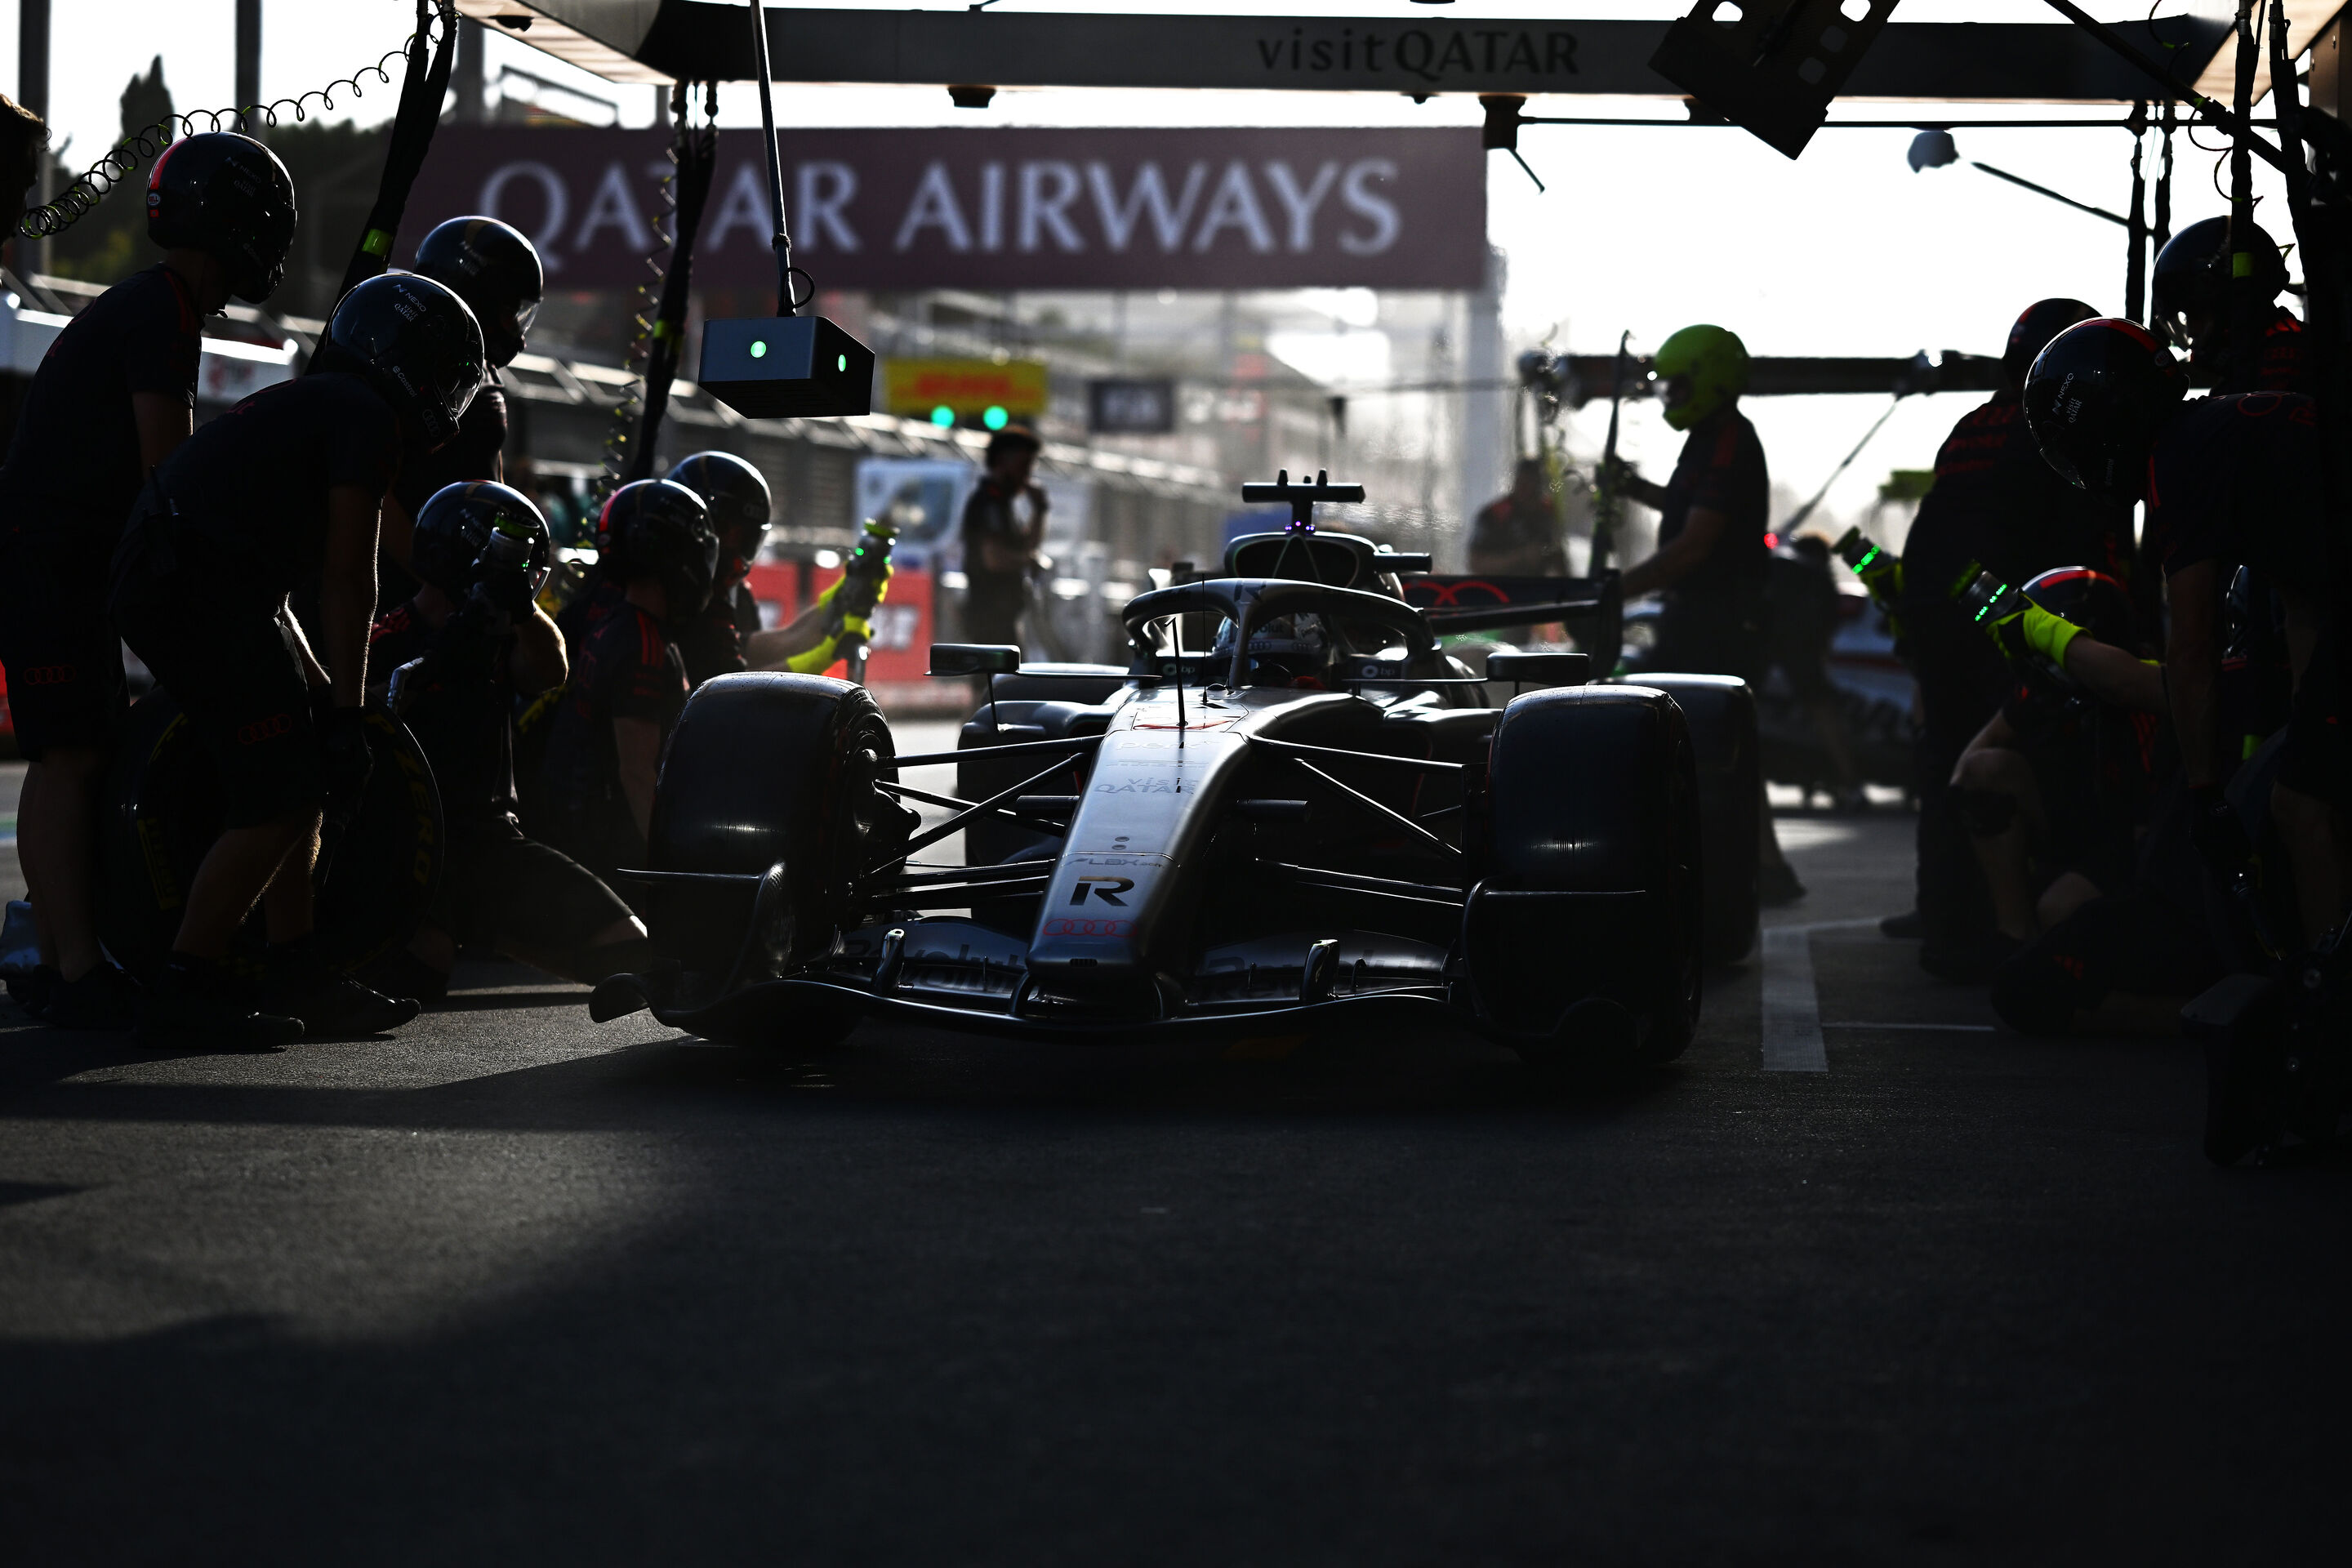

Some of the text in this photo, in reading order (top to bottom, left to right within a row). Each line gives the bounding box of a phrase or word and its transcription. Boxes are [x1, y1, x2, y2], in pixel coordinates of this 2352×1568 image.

[1257, 28, 1579, 81] visitQATAR
[896, 160, 1400, 255] AIRWAYS
[404, 292, 427, 312] NEXO
[2058, 372, 2075, 399] NEXO
[1070, 875, 1135, 906] R
